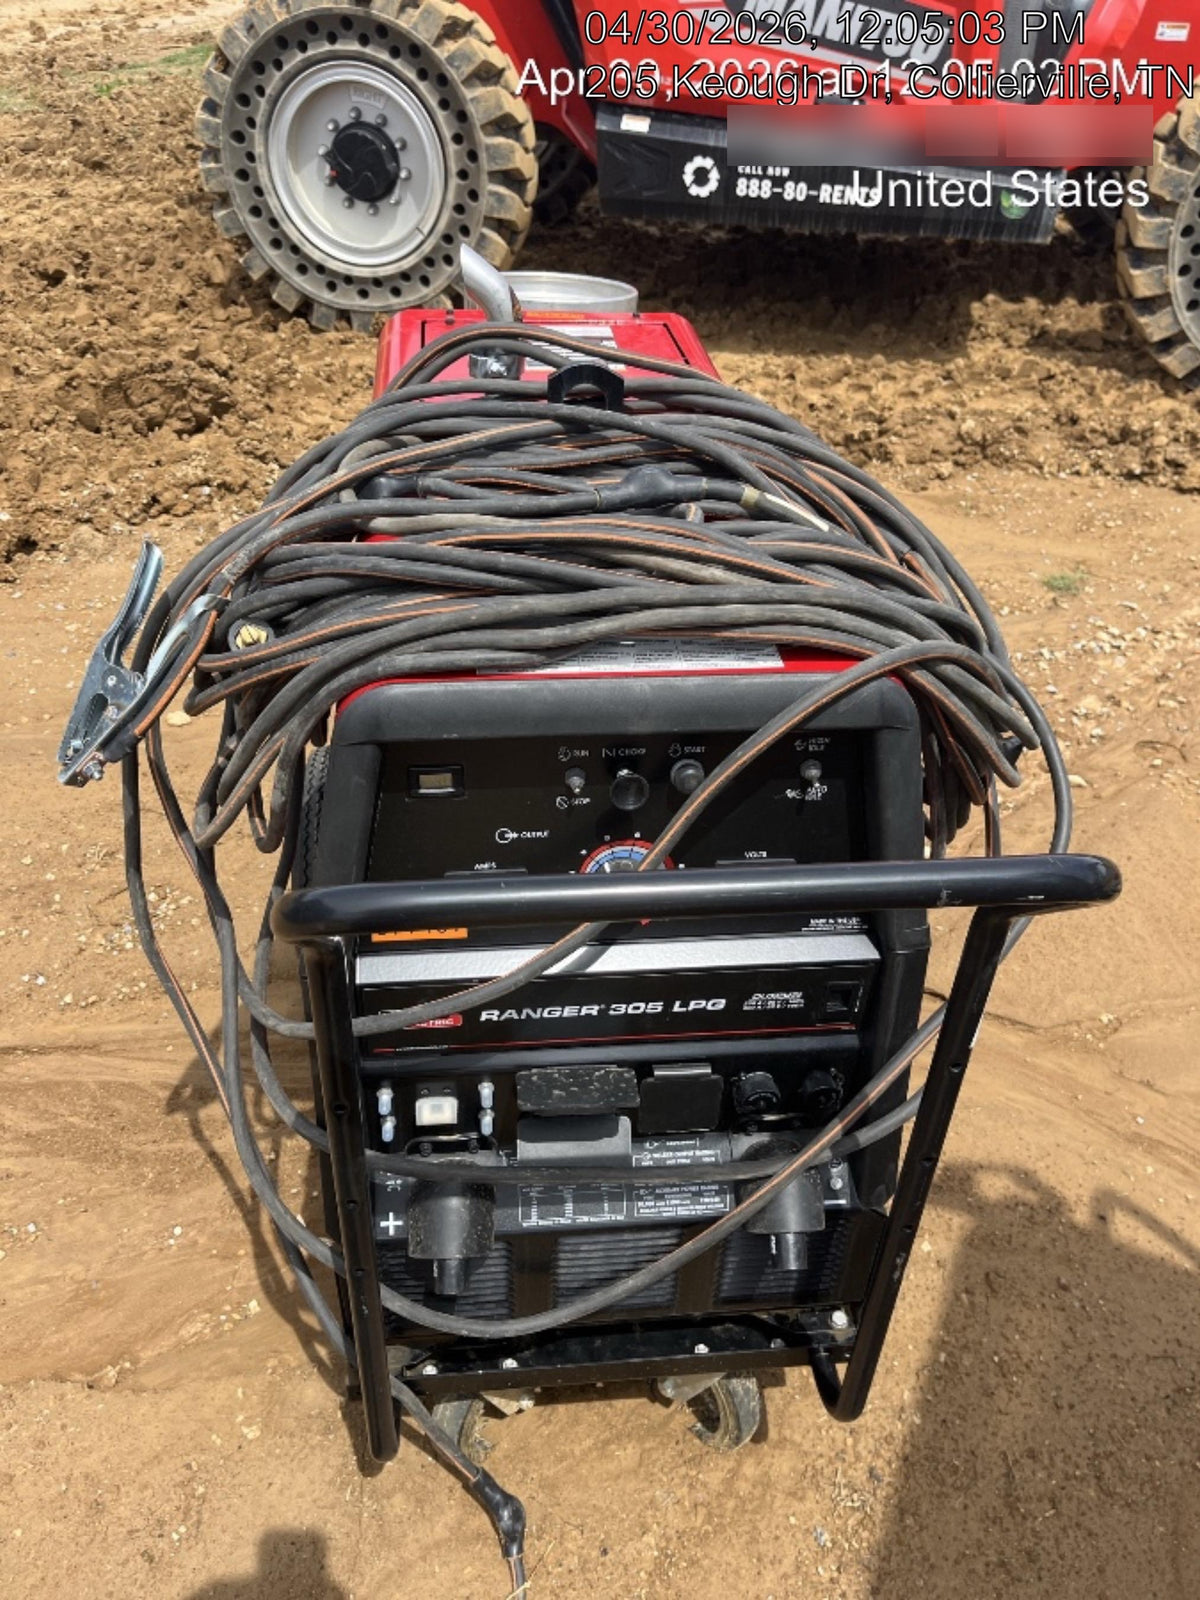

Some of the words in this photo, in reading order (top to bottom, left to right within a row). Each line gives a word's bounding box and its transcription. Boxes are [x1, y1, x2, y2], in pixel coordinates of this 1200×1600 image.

[683, 745, 706, 754] START
[480, 1005, 600, 1021] RANGER
[608, 1001, 663, 1015] 305
[672, 998, 726, 1013] LPG
